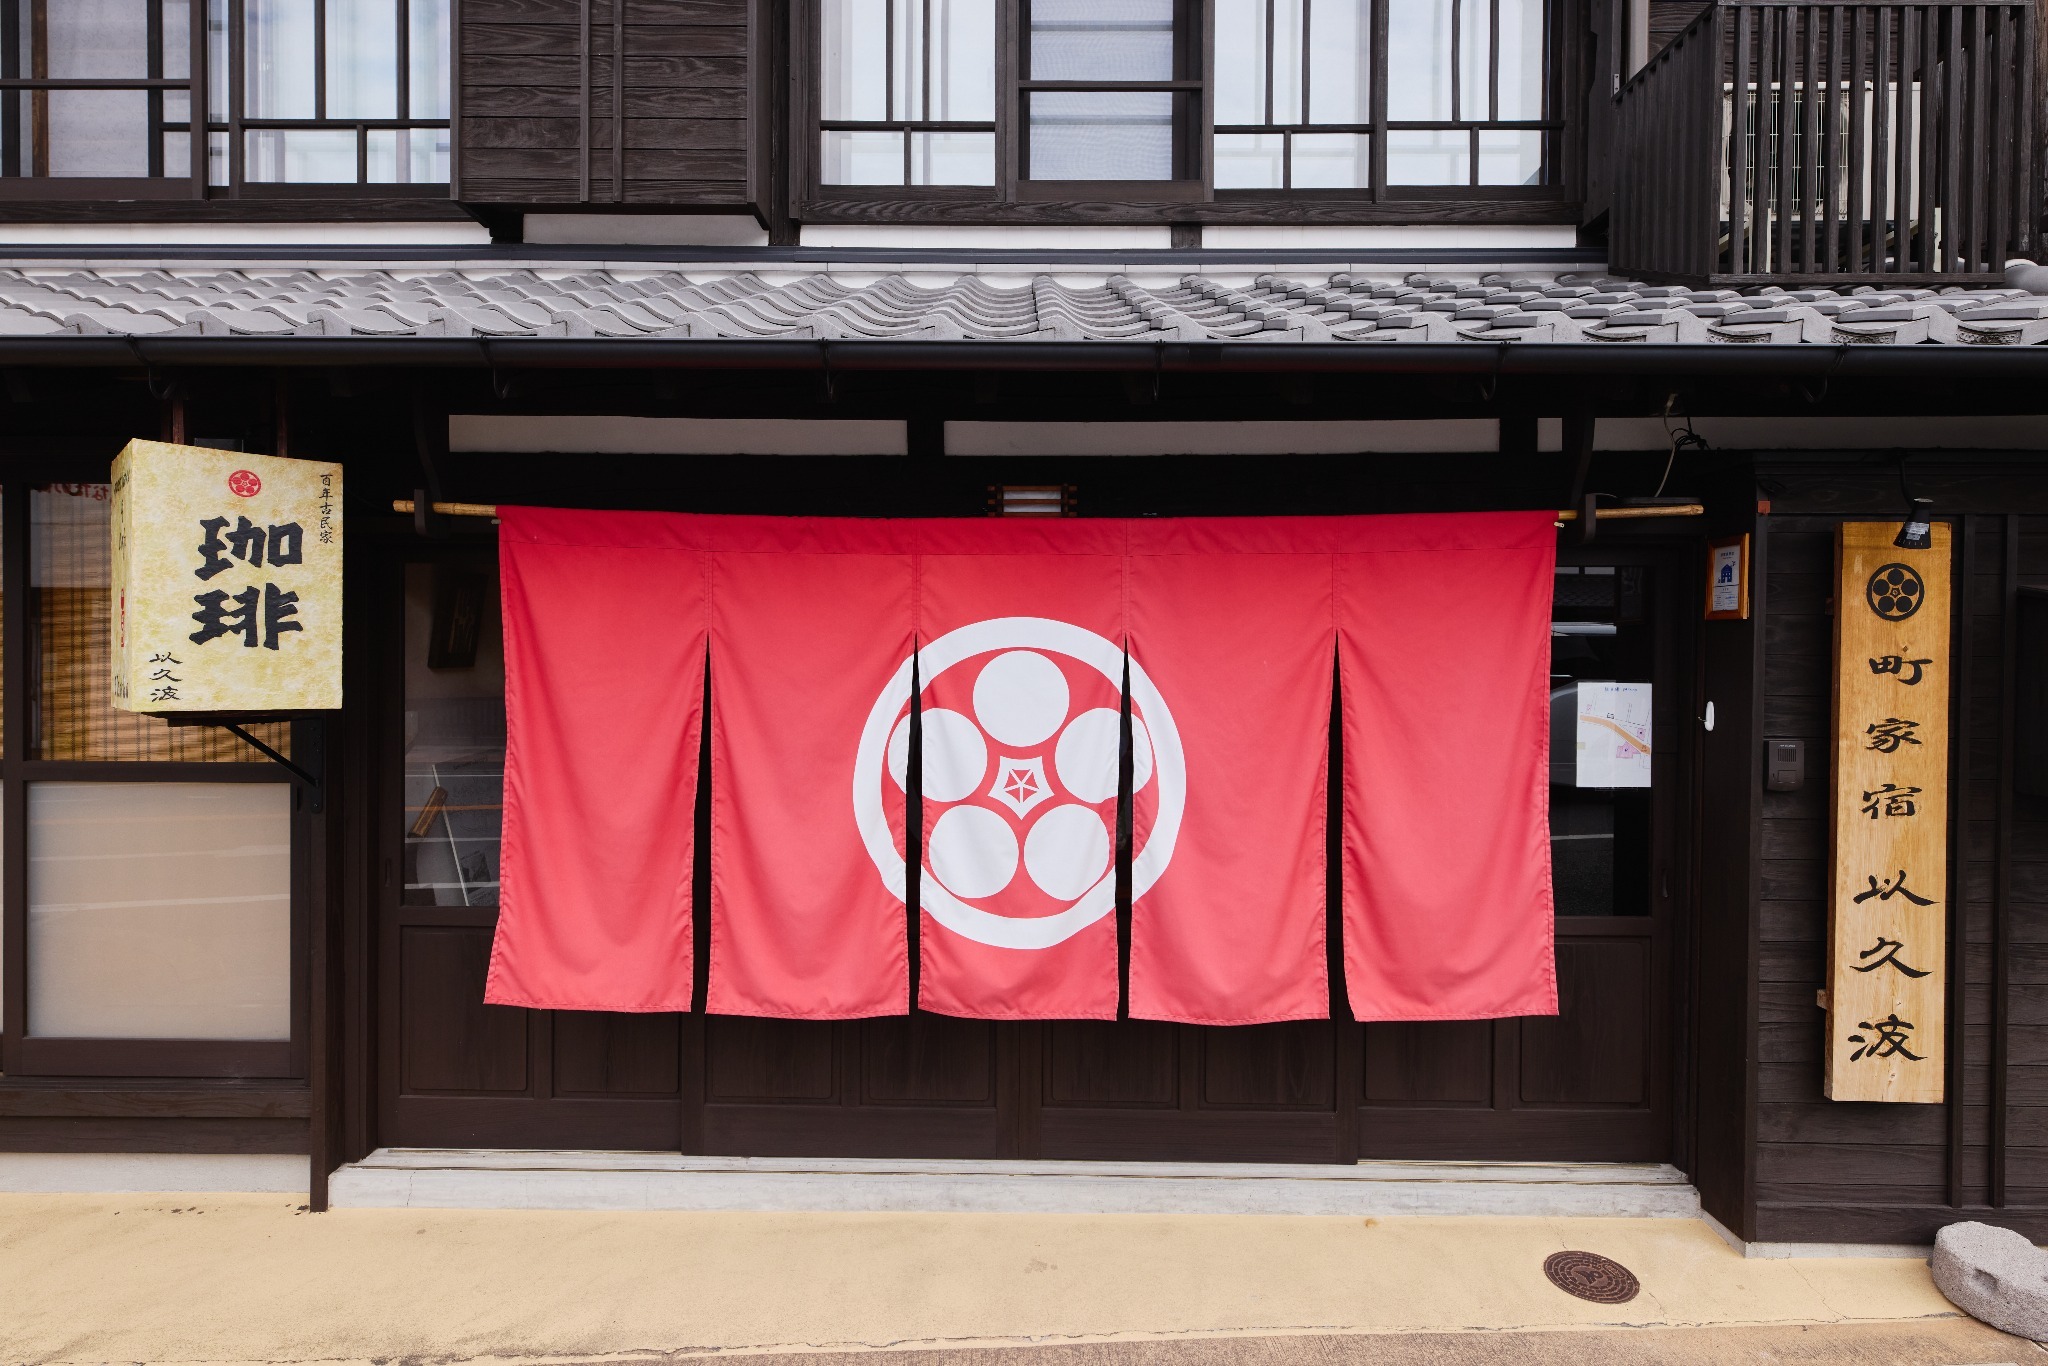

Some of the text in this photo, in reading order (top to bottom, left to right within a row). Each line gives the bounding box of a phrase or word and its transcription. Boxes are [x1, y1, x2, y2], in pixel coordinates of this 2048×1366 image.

[319, 473, 334, 544] 百年古民家
[188, 515, 304, 651] 珈琲
[149, 651, 183, 702] 以久波
